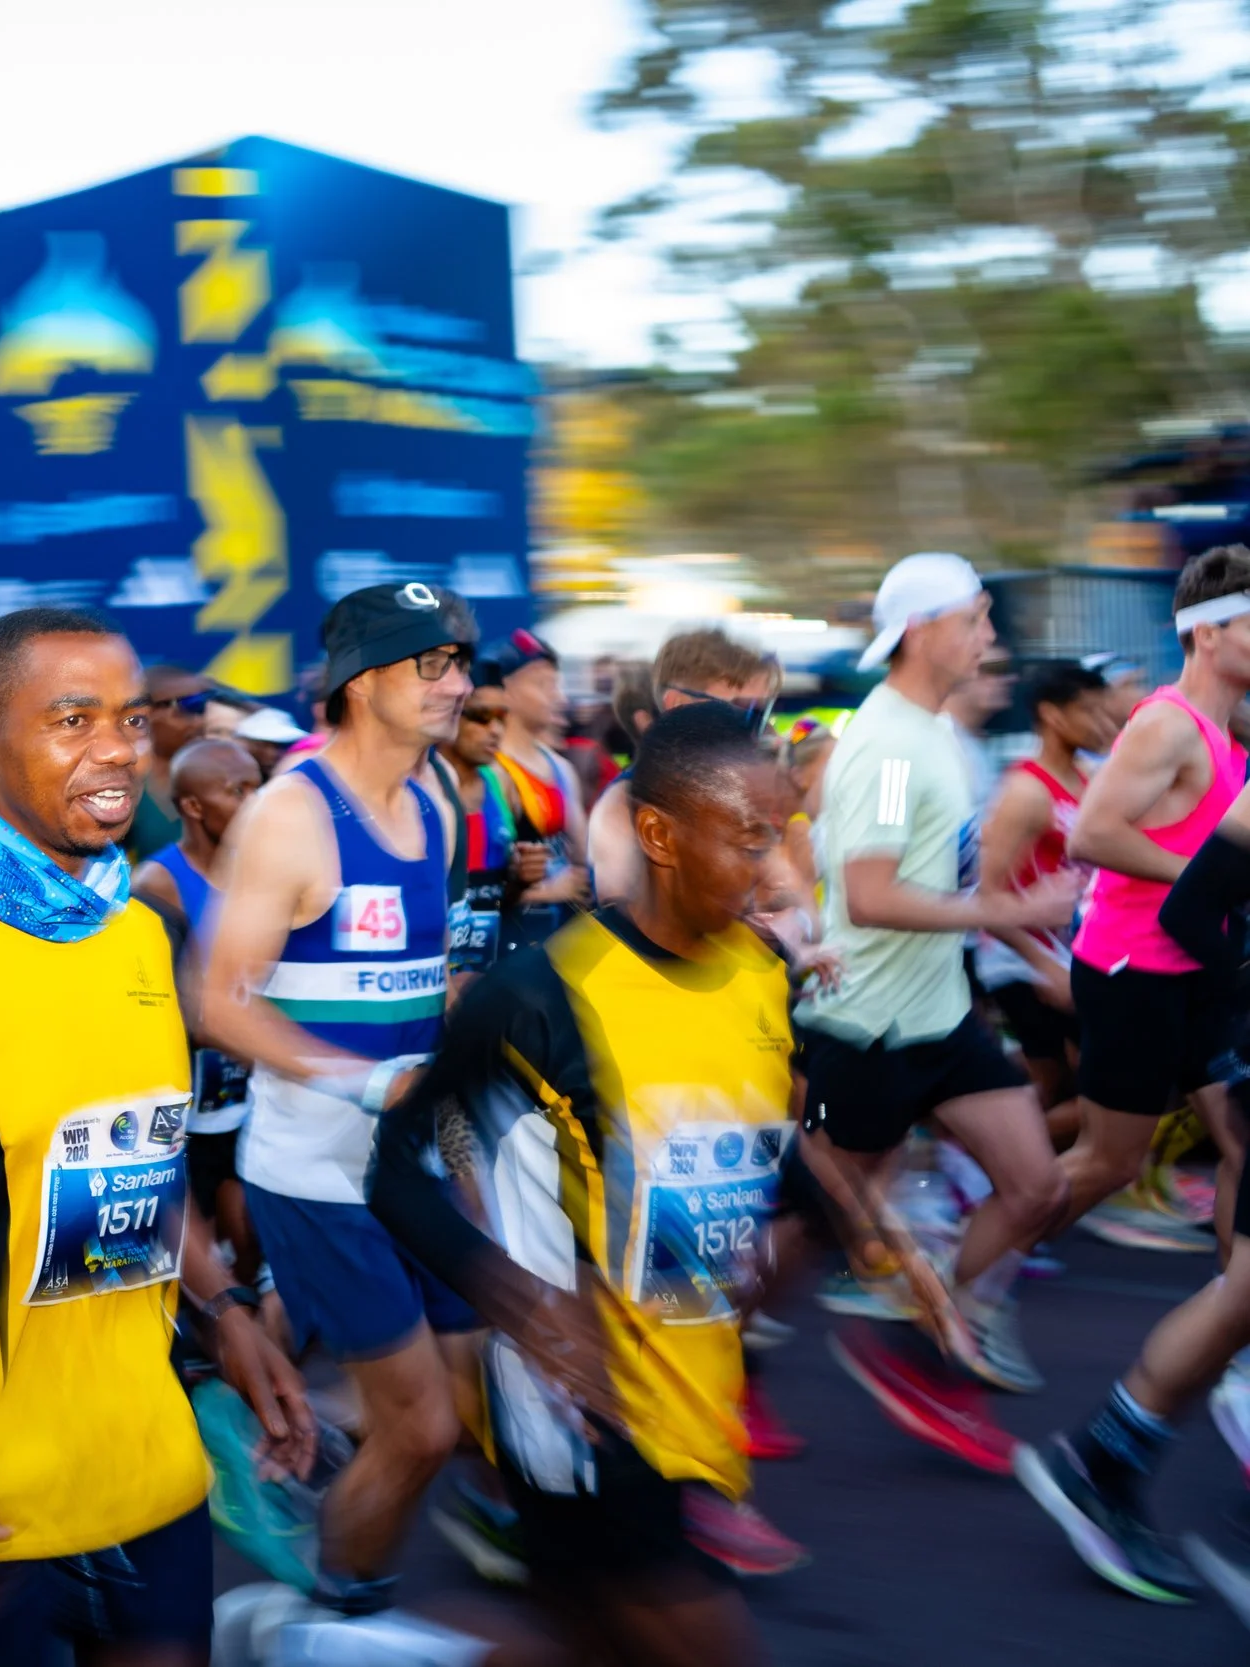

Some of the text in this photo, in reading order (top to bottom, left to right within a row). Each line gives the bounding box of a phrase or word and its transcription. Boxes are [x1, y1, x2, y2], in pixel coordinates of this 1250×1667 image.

[357, 898, 402, 939] 45
[63, 1127, 90, 1145] WPA
[65, 1144, 90, 1163] 2024
[111, 1167, 176, 1193] Sanlam
[707, 1187, 763, 1210] Sanlam
[98, 1196, 159, 1238] 1511
[694, 1216, 754, 1255] 1512
[45, 1276, 69, 1290] ASA
